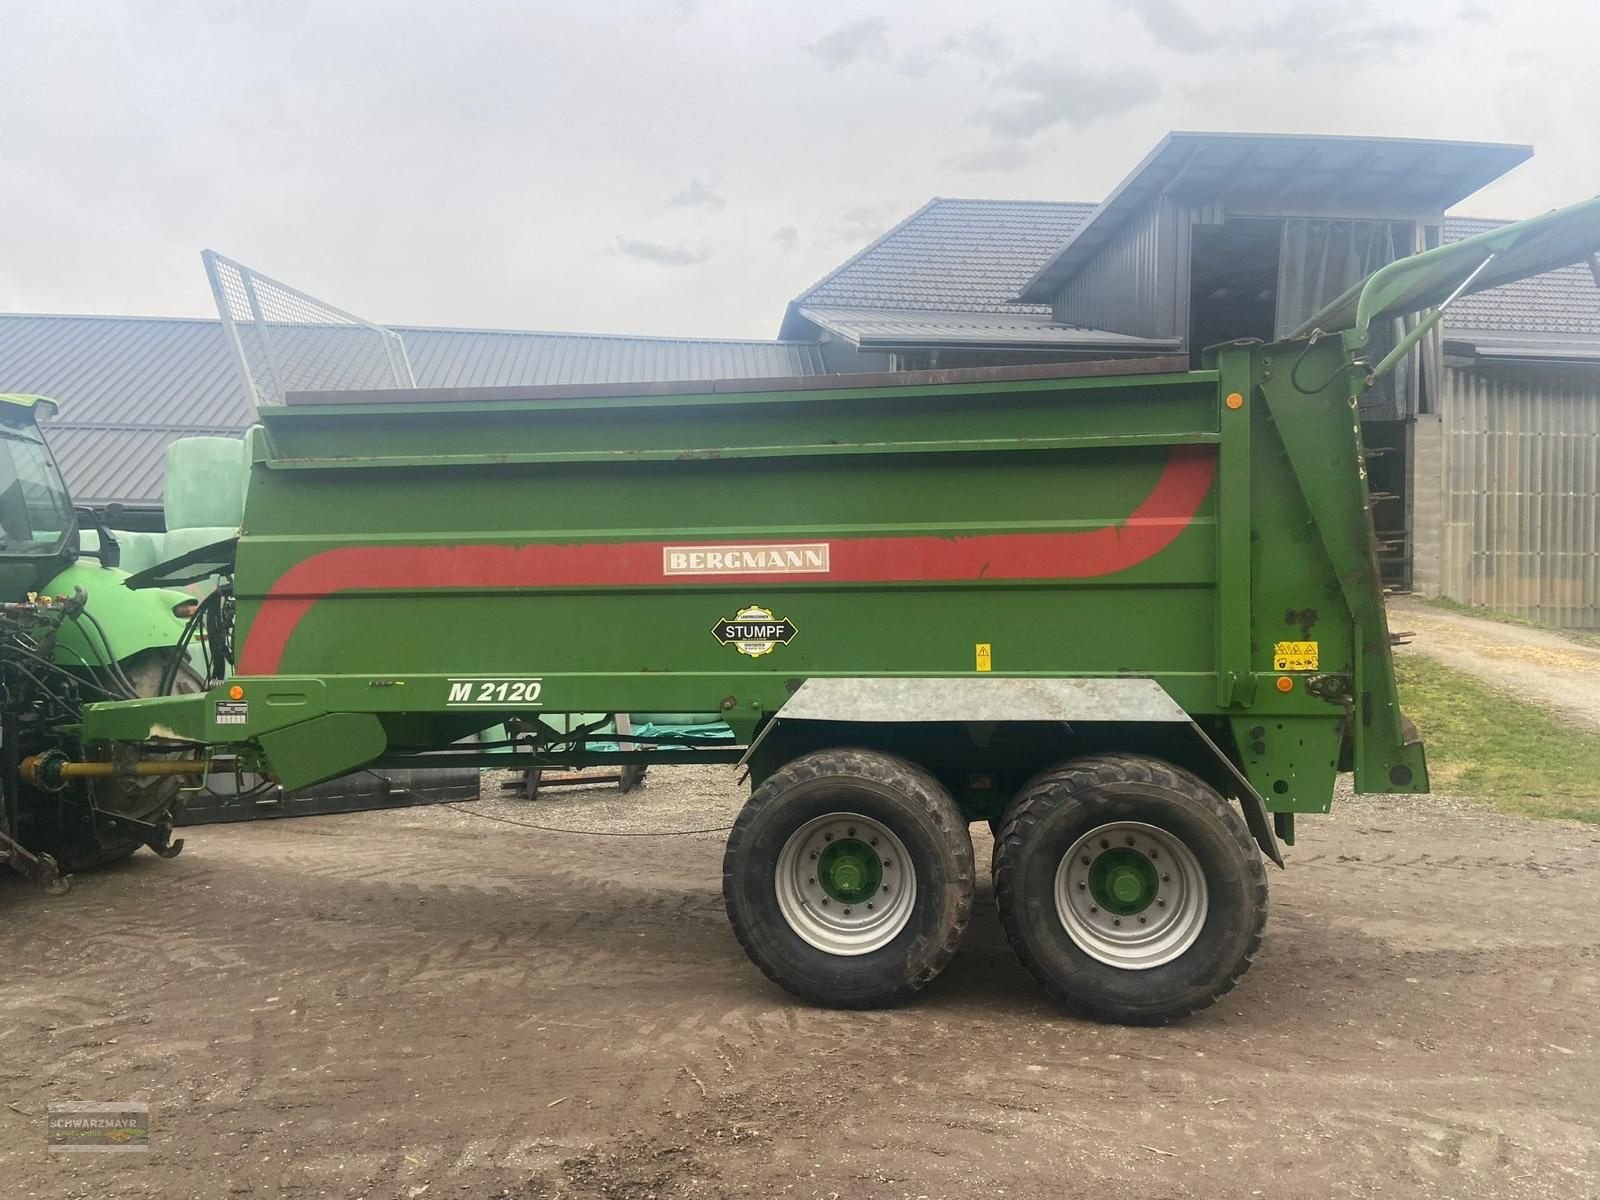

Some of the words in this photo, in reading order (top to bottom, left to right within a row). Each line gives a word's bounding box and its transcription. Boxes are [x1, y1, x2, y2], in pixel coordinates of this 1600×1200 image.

[670, 550, 823, 569] BERGMANN
[726, 625, 785, 638] STUMPF
[448, 683, 473, 701] M
[476, 682, 542, 701] 2120
